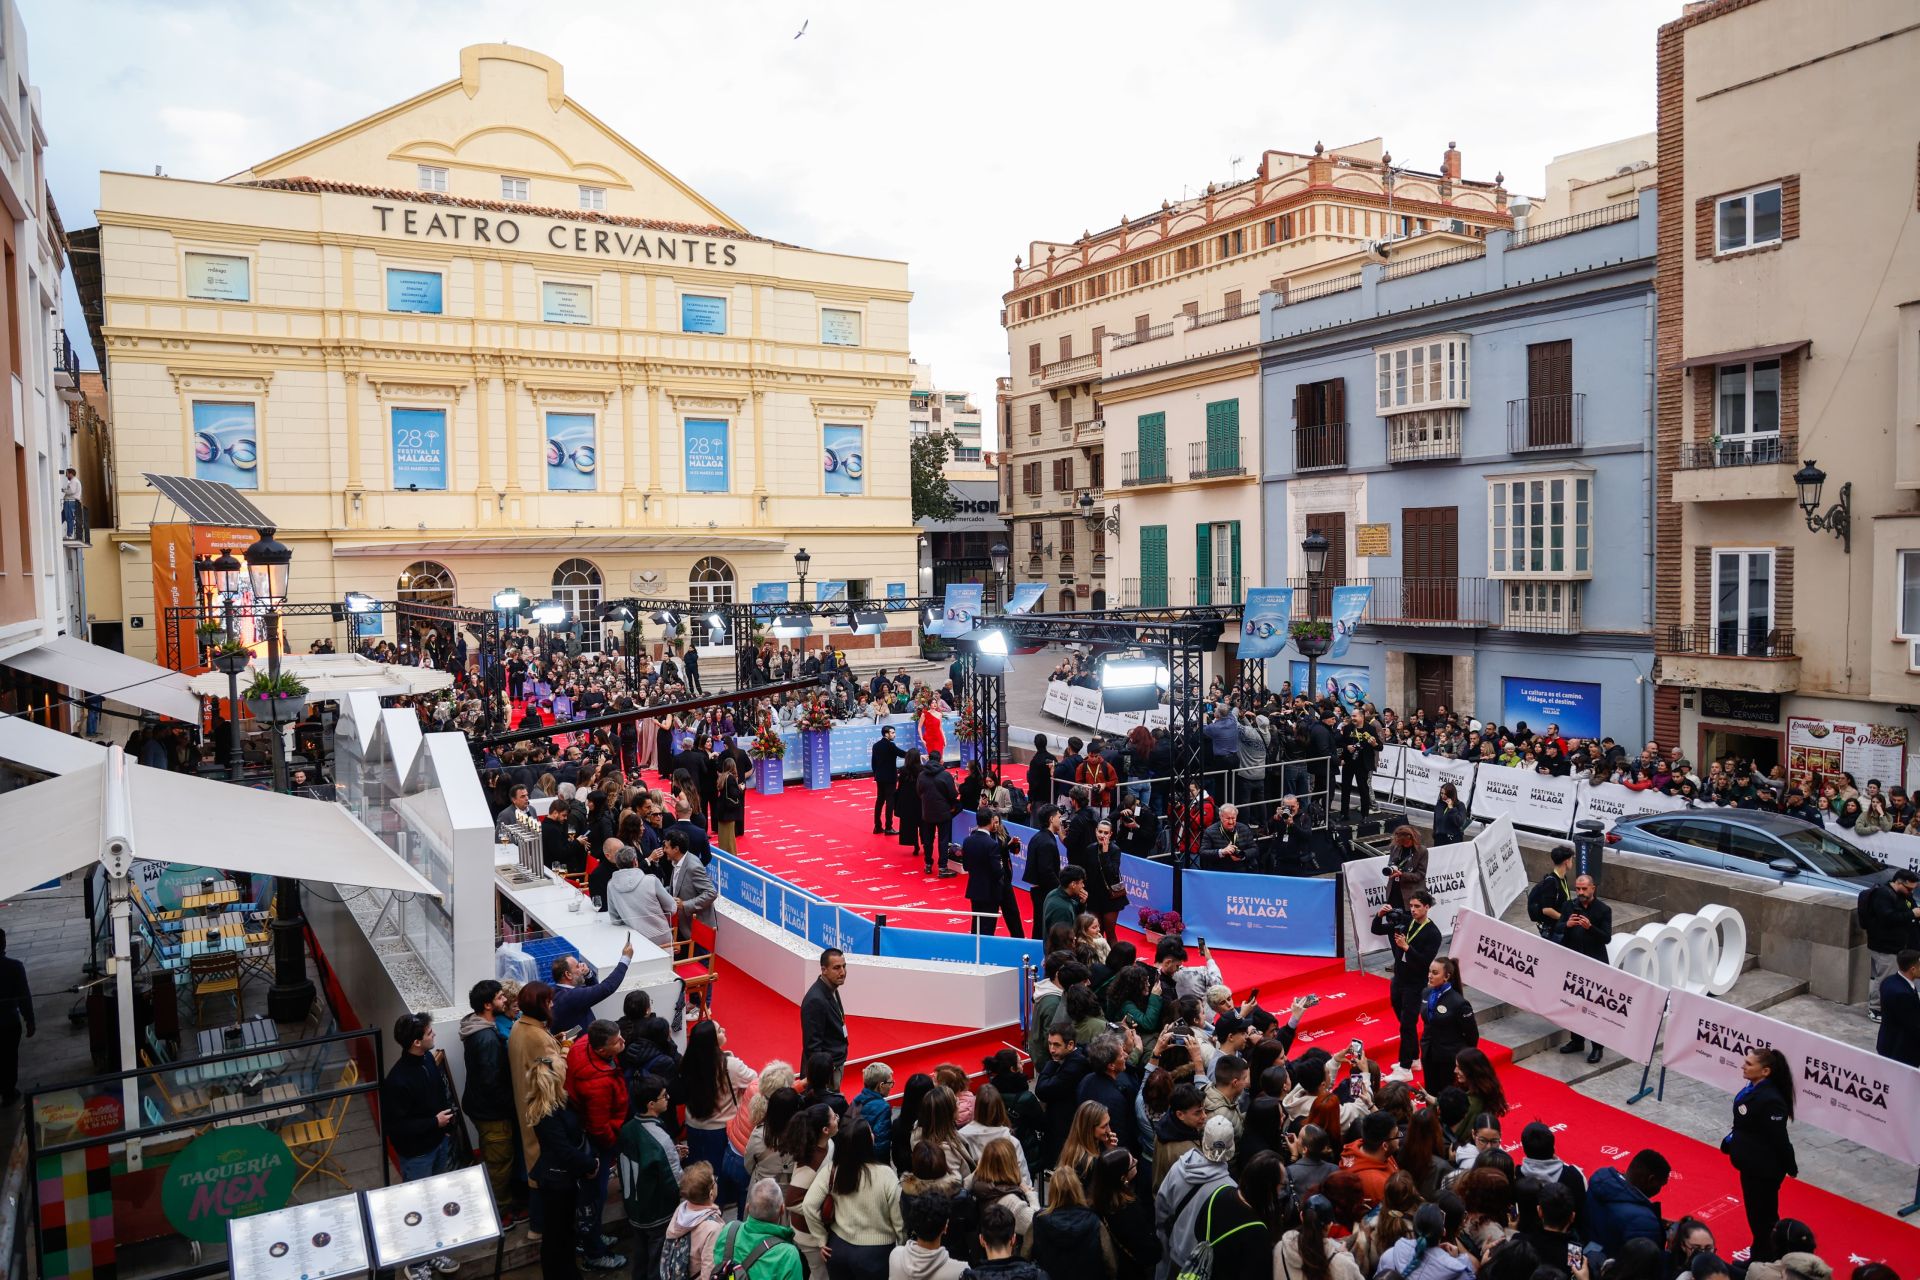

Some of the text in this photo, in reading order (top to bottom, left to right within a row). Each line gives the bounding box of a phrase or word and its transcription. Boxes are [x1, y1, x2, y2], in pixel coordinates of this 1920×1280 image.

[372, 205, 738, 267] TEATRO CERVANTES
[397, 429, 423, 448] 28
[689, 437, 710, 454] 28
[1527, 695, 1548, 704] Málaga,
[1554, 698, 1577, 706] destino.
[1528, 689, 1547, 697] cultura
[1561, 692, 1584, 700] camino.
[1732, 710, 1775, 722] CERVANTES
[1857, 734, 1894, 746] Pizzas
[1407, 763, 1424, 772] FESTIVAL
[1439, 771, 1458, 779] FESTIVAL
[1487, 780, 1511, 789] FESTIVAL
[1531, 787, 1556, 796] FESTIVAL
[1590, 798, 1616, 807] FESTIVAL
[1456, 870, 1465, 878] DE
[1140, 880, 1150, 889] DE
[1125, 883, 1149, 901] LAGA
[1226, 895, 1288, 907] FESTIVAL DE
[846, 936, 854, 945] DE
[1479, 934, 1539, 966] FESTIVAL DE
[1476, 942, 1535, 978] MÁLAGA
[1565, 971, 1633, 1005] FESTIVAL DE
[1562, 980, 1628, 1017] MÁLAGA
[1698, 1018, 1772, 1050] FESTIVAL DE
[1805, 1055, 1890, 1094] FESTIVAL DE
[1803, 1066, 1888, 1110] MÁLAGA
[178, 1152, 283, 1187] TAQUERÍA
[187, 1167, 273, 1222] MEX
